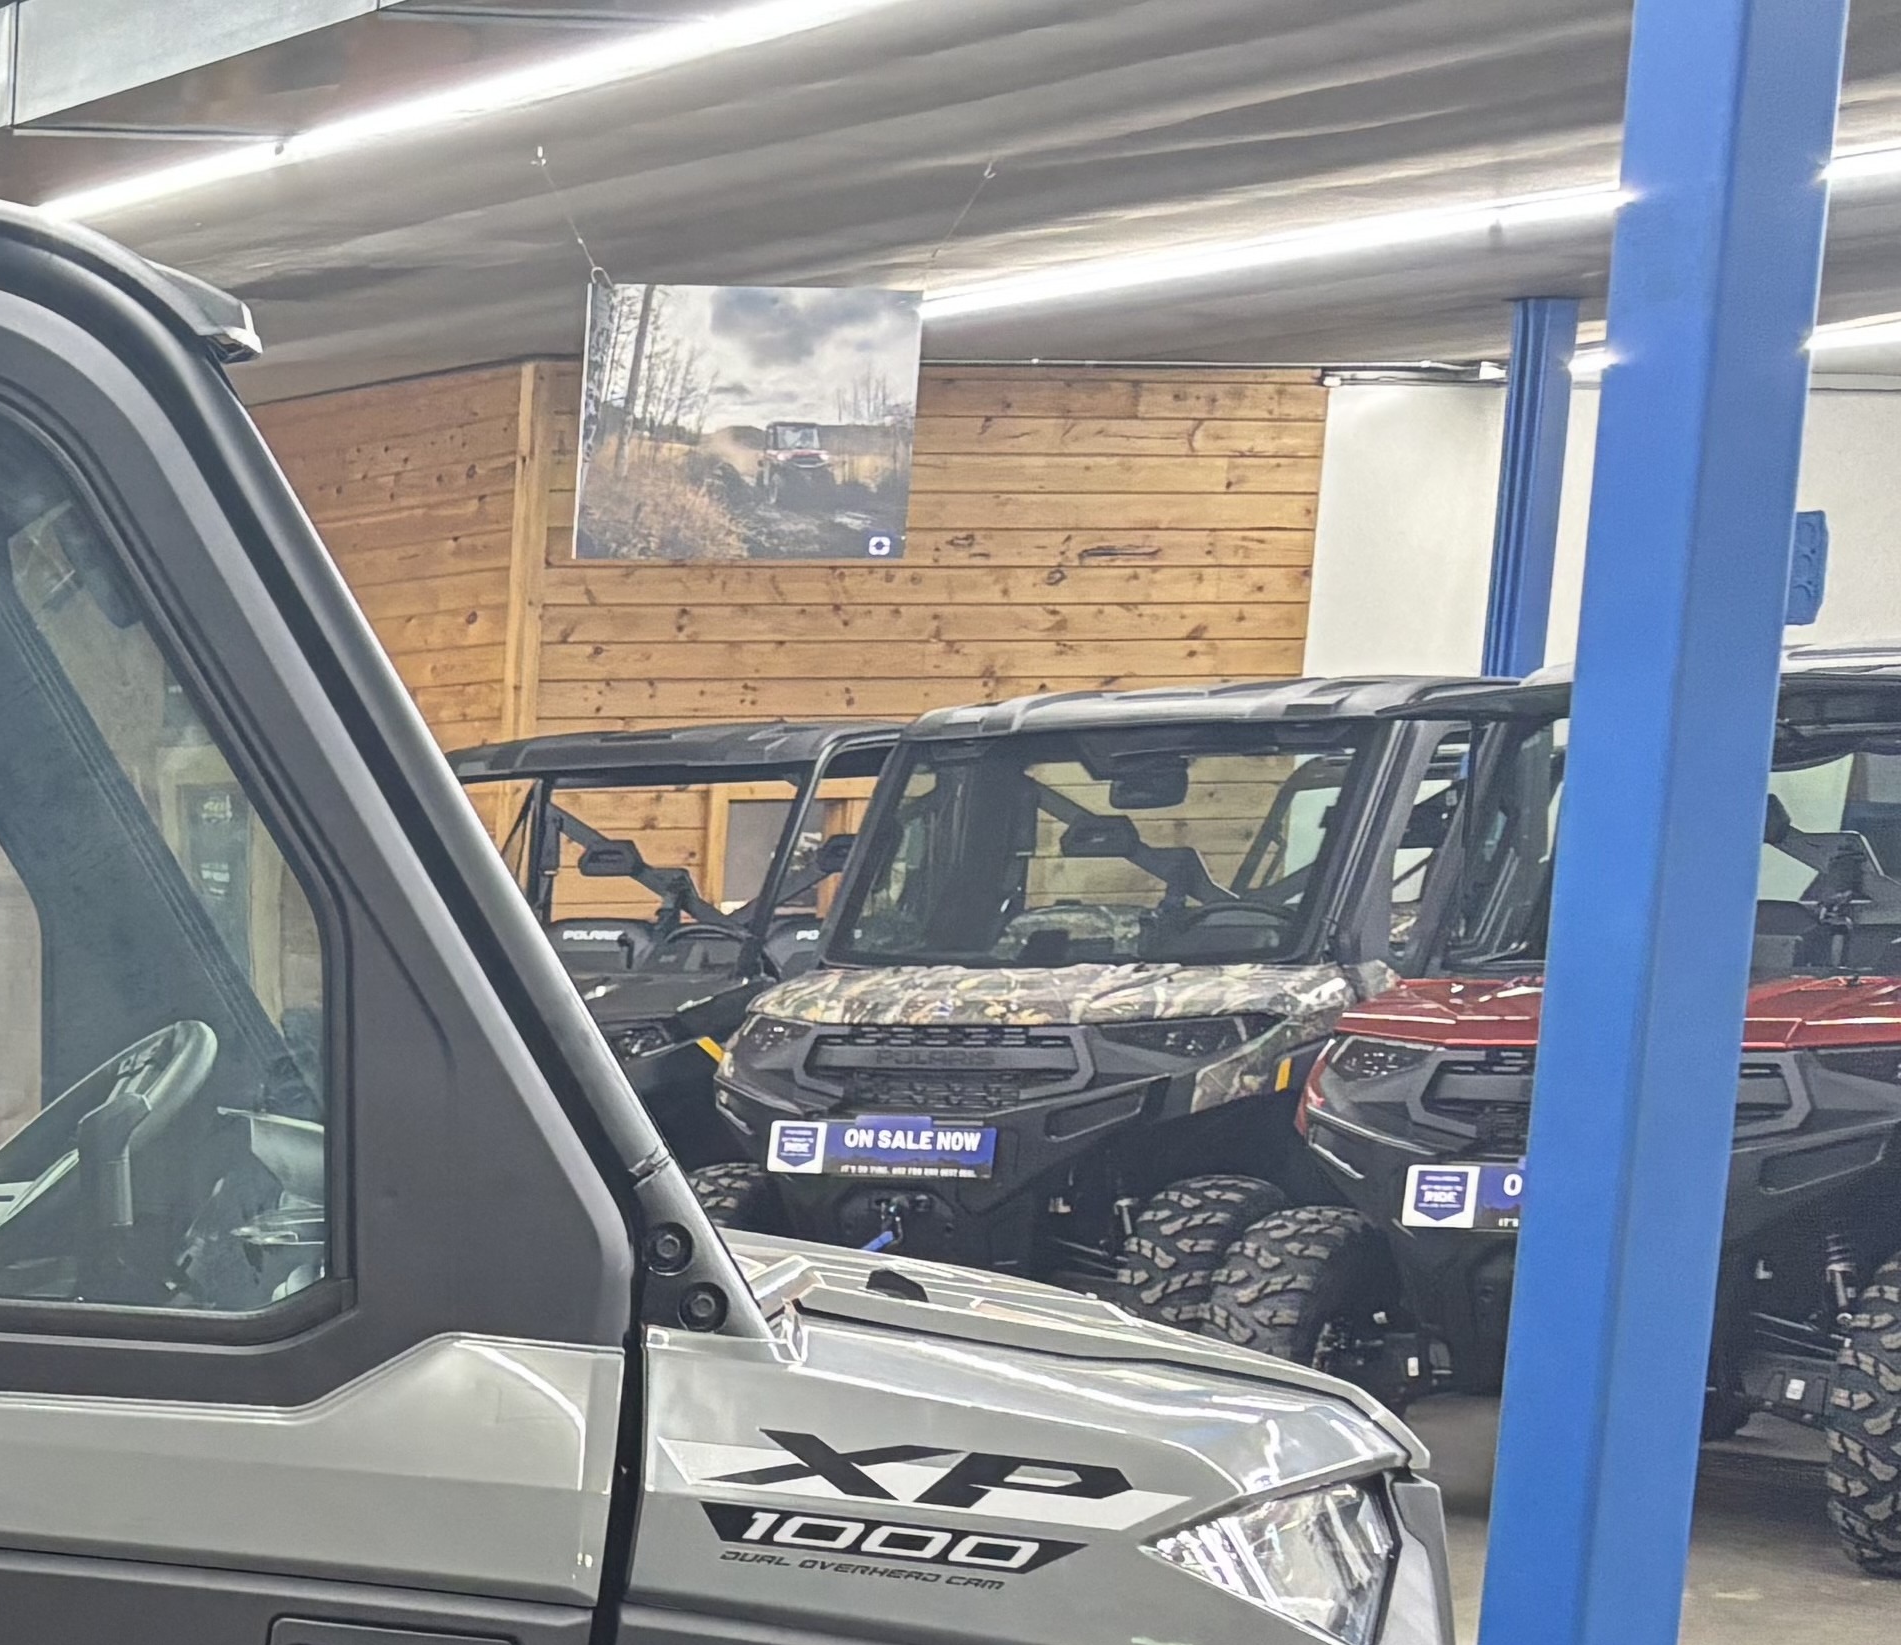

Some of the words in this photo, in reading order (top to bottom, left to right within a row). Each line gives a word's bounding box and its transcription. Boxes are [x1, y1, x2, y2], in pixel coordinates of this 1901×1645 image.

[876, 1048, 997, 1066] POLARIS
[844, 1128, 875, 1149] ON
[877, 1129, 935, 1150] SALE
[936, 1131, 982, 1152] NOW
[699, 1427, 1135, 1509] XP
[741, 1511, 1041, 1570] 1000
[719, 1550, 791, 1568] DUAL
[798, 1558, 942, 1583] OVERHEAD
[945, 1575, 1005, 1591] CAM
